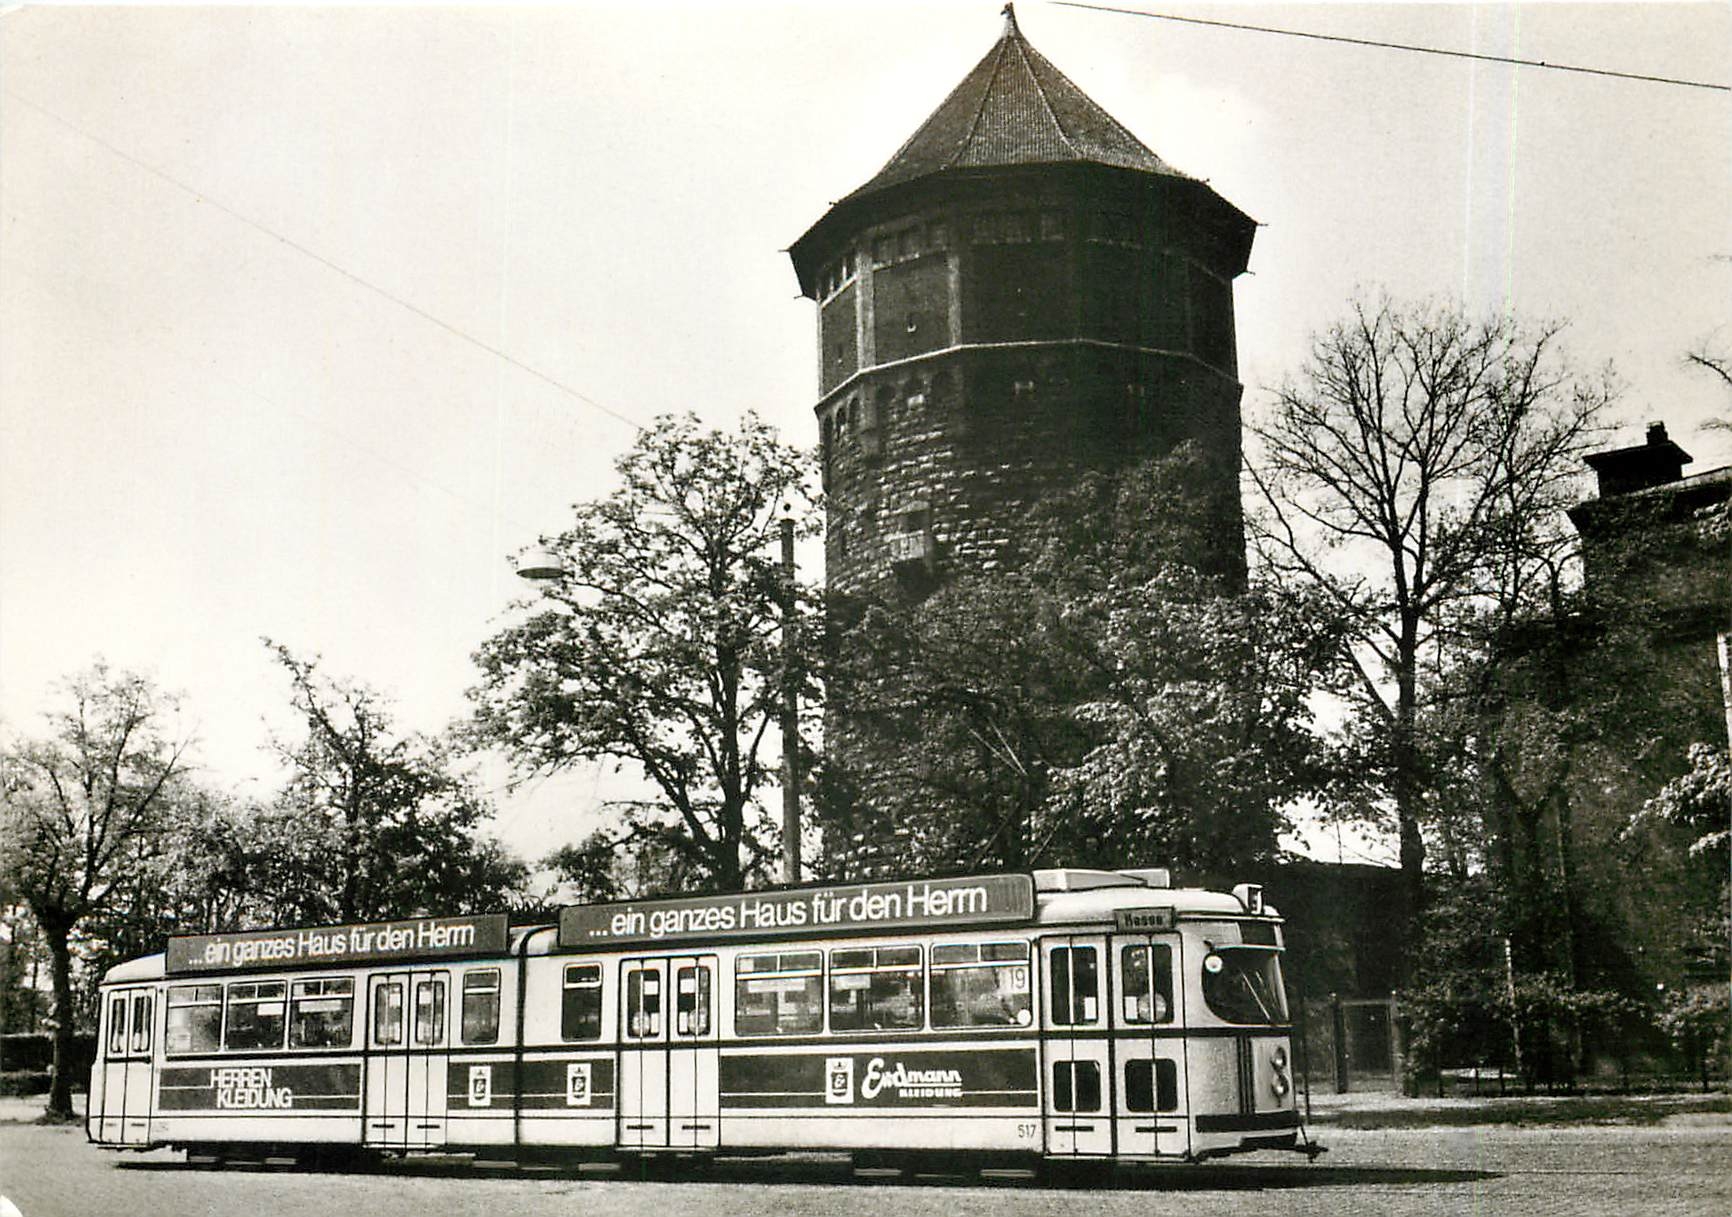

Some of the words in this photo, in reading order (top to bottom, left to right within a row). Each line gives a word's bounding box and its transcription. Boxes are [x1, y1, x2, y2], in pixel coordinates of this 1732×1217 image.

[650, 905, 735, 938] ganzes
[740, 899, 808, 928] Haus
[812, 891, 846, 924] für
[850, 889, 900, 921] den
[907, 884, 987, 917] Herrn
[232, 937, 295, 967] ganzes
[298, 931, 347, 956] Haus
[350, 926, 375, 953] für
[377, 924, 414, 951] den
[417, 921, 475, 948] Herrn
[1010, 968, 1026, 989] 19
[210, 1068, 272, 1088] HERREN
[861, 1058, 962, 1099] Erdmann
[217, 1087, 292, 1109] KLEIDUNG
[1018, 1125, 1036, 1139] 517
